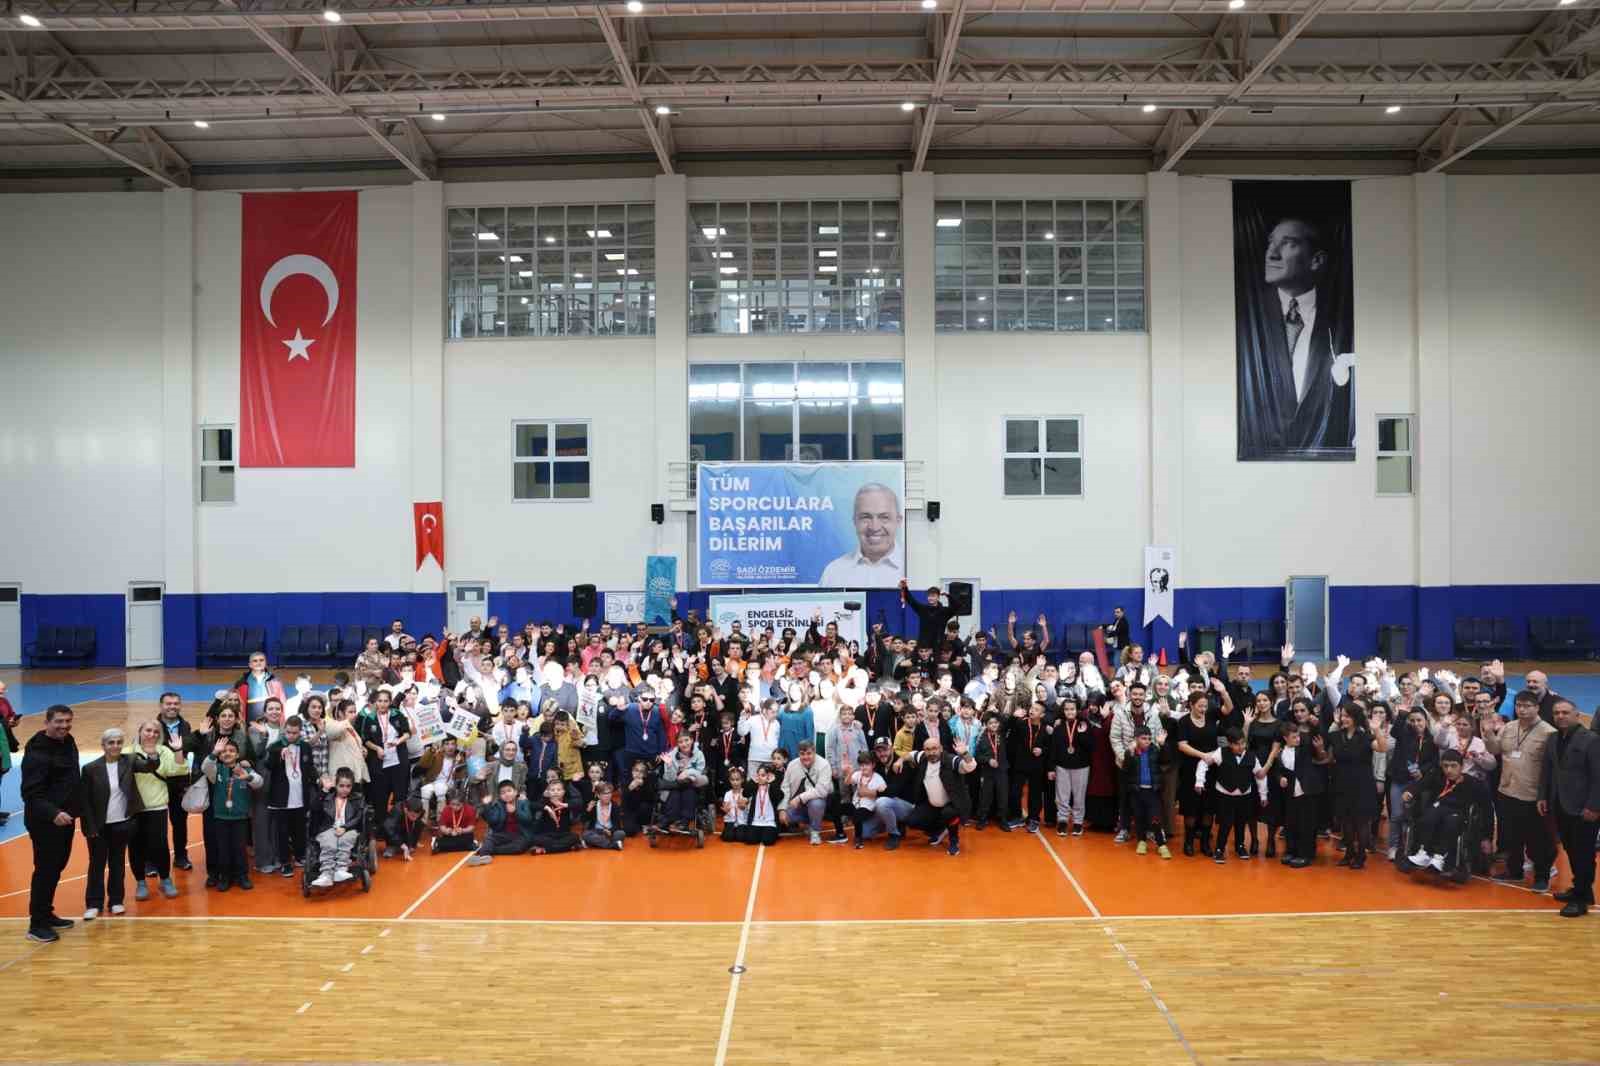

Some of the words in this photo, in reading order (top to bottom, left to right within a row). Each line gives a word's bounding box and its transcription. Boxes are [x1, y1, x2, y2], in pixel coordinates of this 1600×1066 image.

[709, 473, 750, 491] TÜM
[709, 495, 834, 511] SPORCULARA
[709, 516, 813, 536] BAŞARILAR
[709, 533, 783, 551] DİLERİM
[748, 608, 794, 618] ENGELSİZ
[748, 619, 774, 628] SPOR
